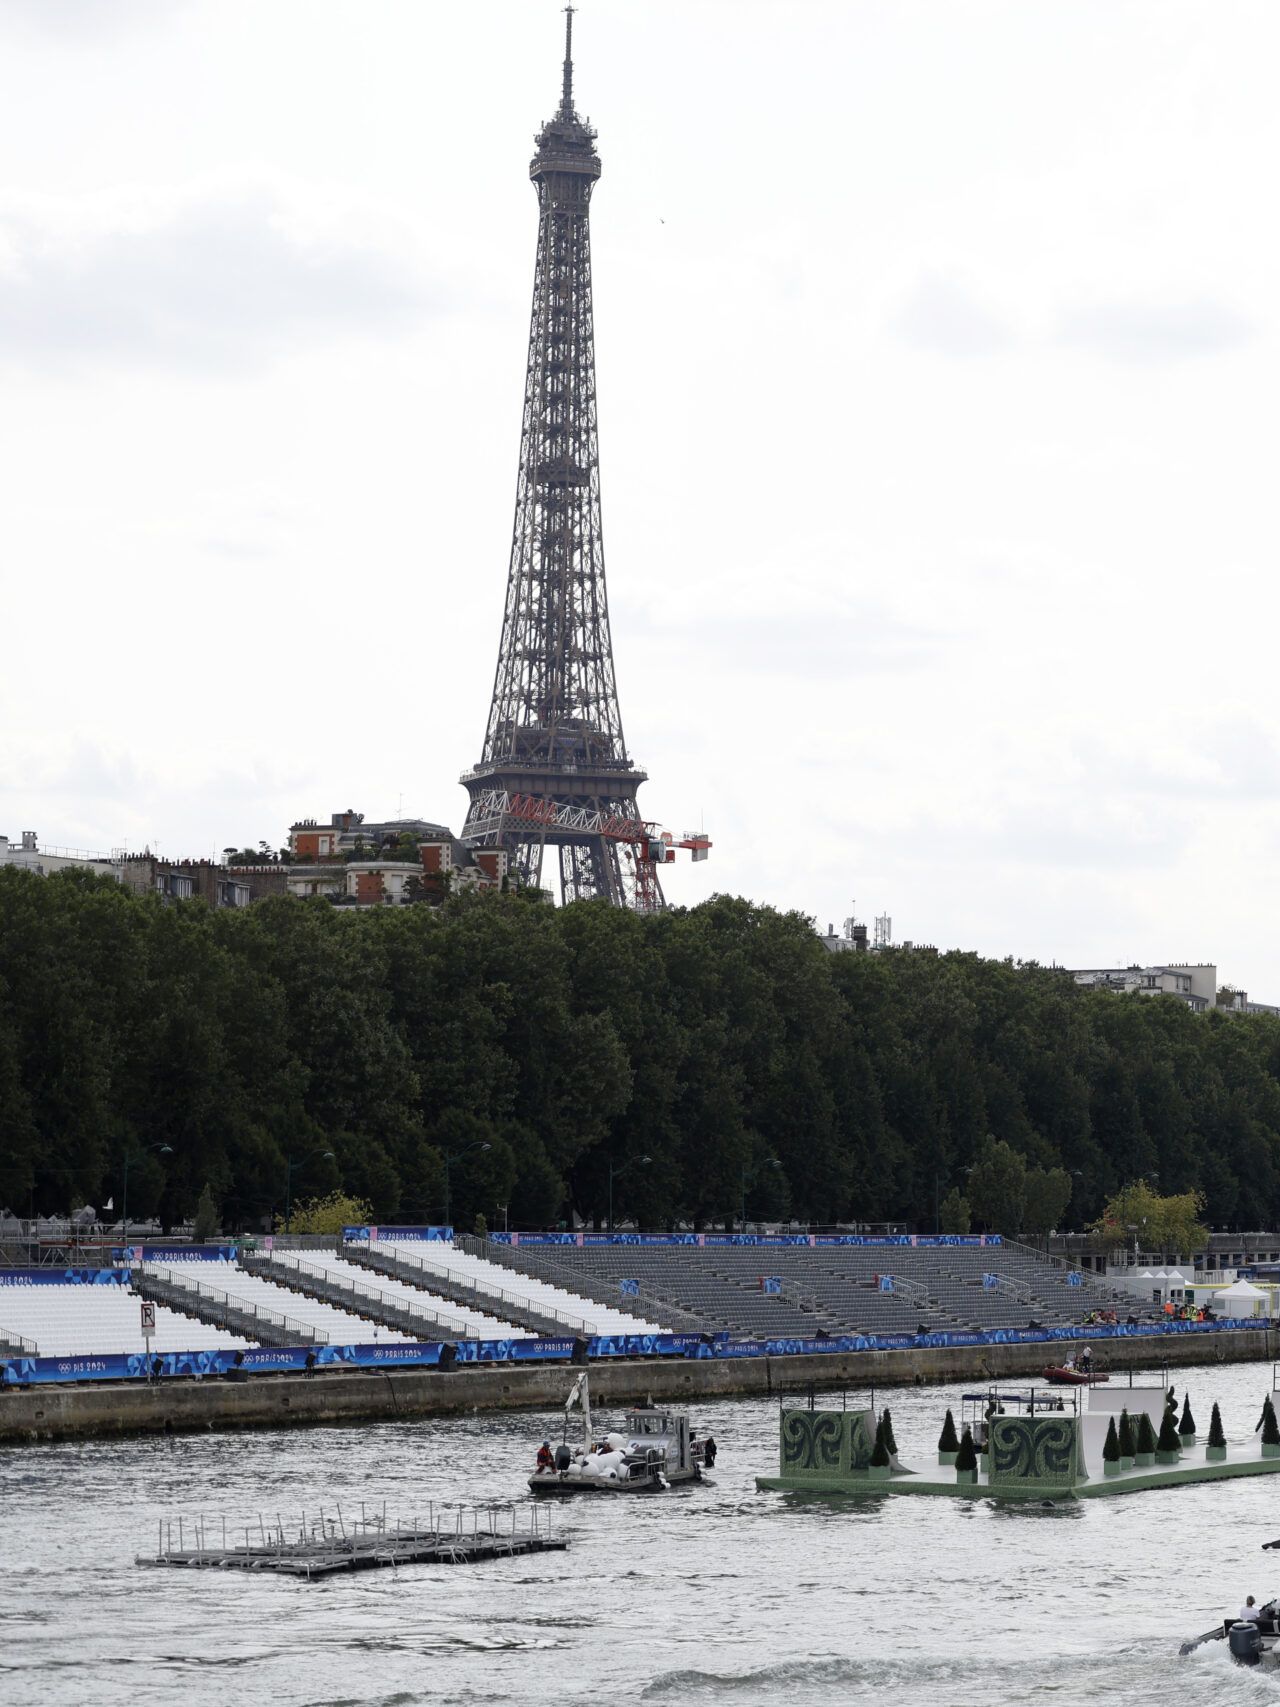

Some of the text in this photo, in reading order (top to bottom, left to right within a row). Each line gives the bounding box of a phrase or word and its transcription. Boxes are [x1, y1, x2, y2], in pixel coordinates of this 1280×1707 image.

[388, 1232, 421, 1241] PARIS 2024
[164, 1252, 202, 1261] PARIS 2024
[13, 1276, 33, 1285] 2024
[544, 1342, 574, 1352] PARIS 202
[255, 1353, 294, 1364] PARIS 2024
[384, 1349, 422, 1359] PARIS 2024
[86, 1361, 106, 1372] 2024
